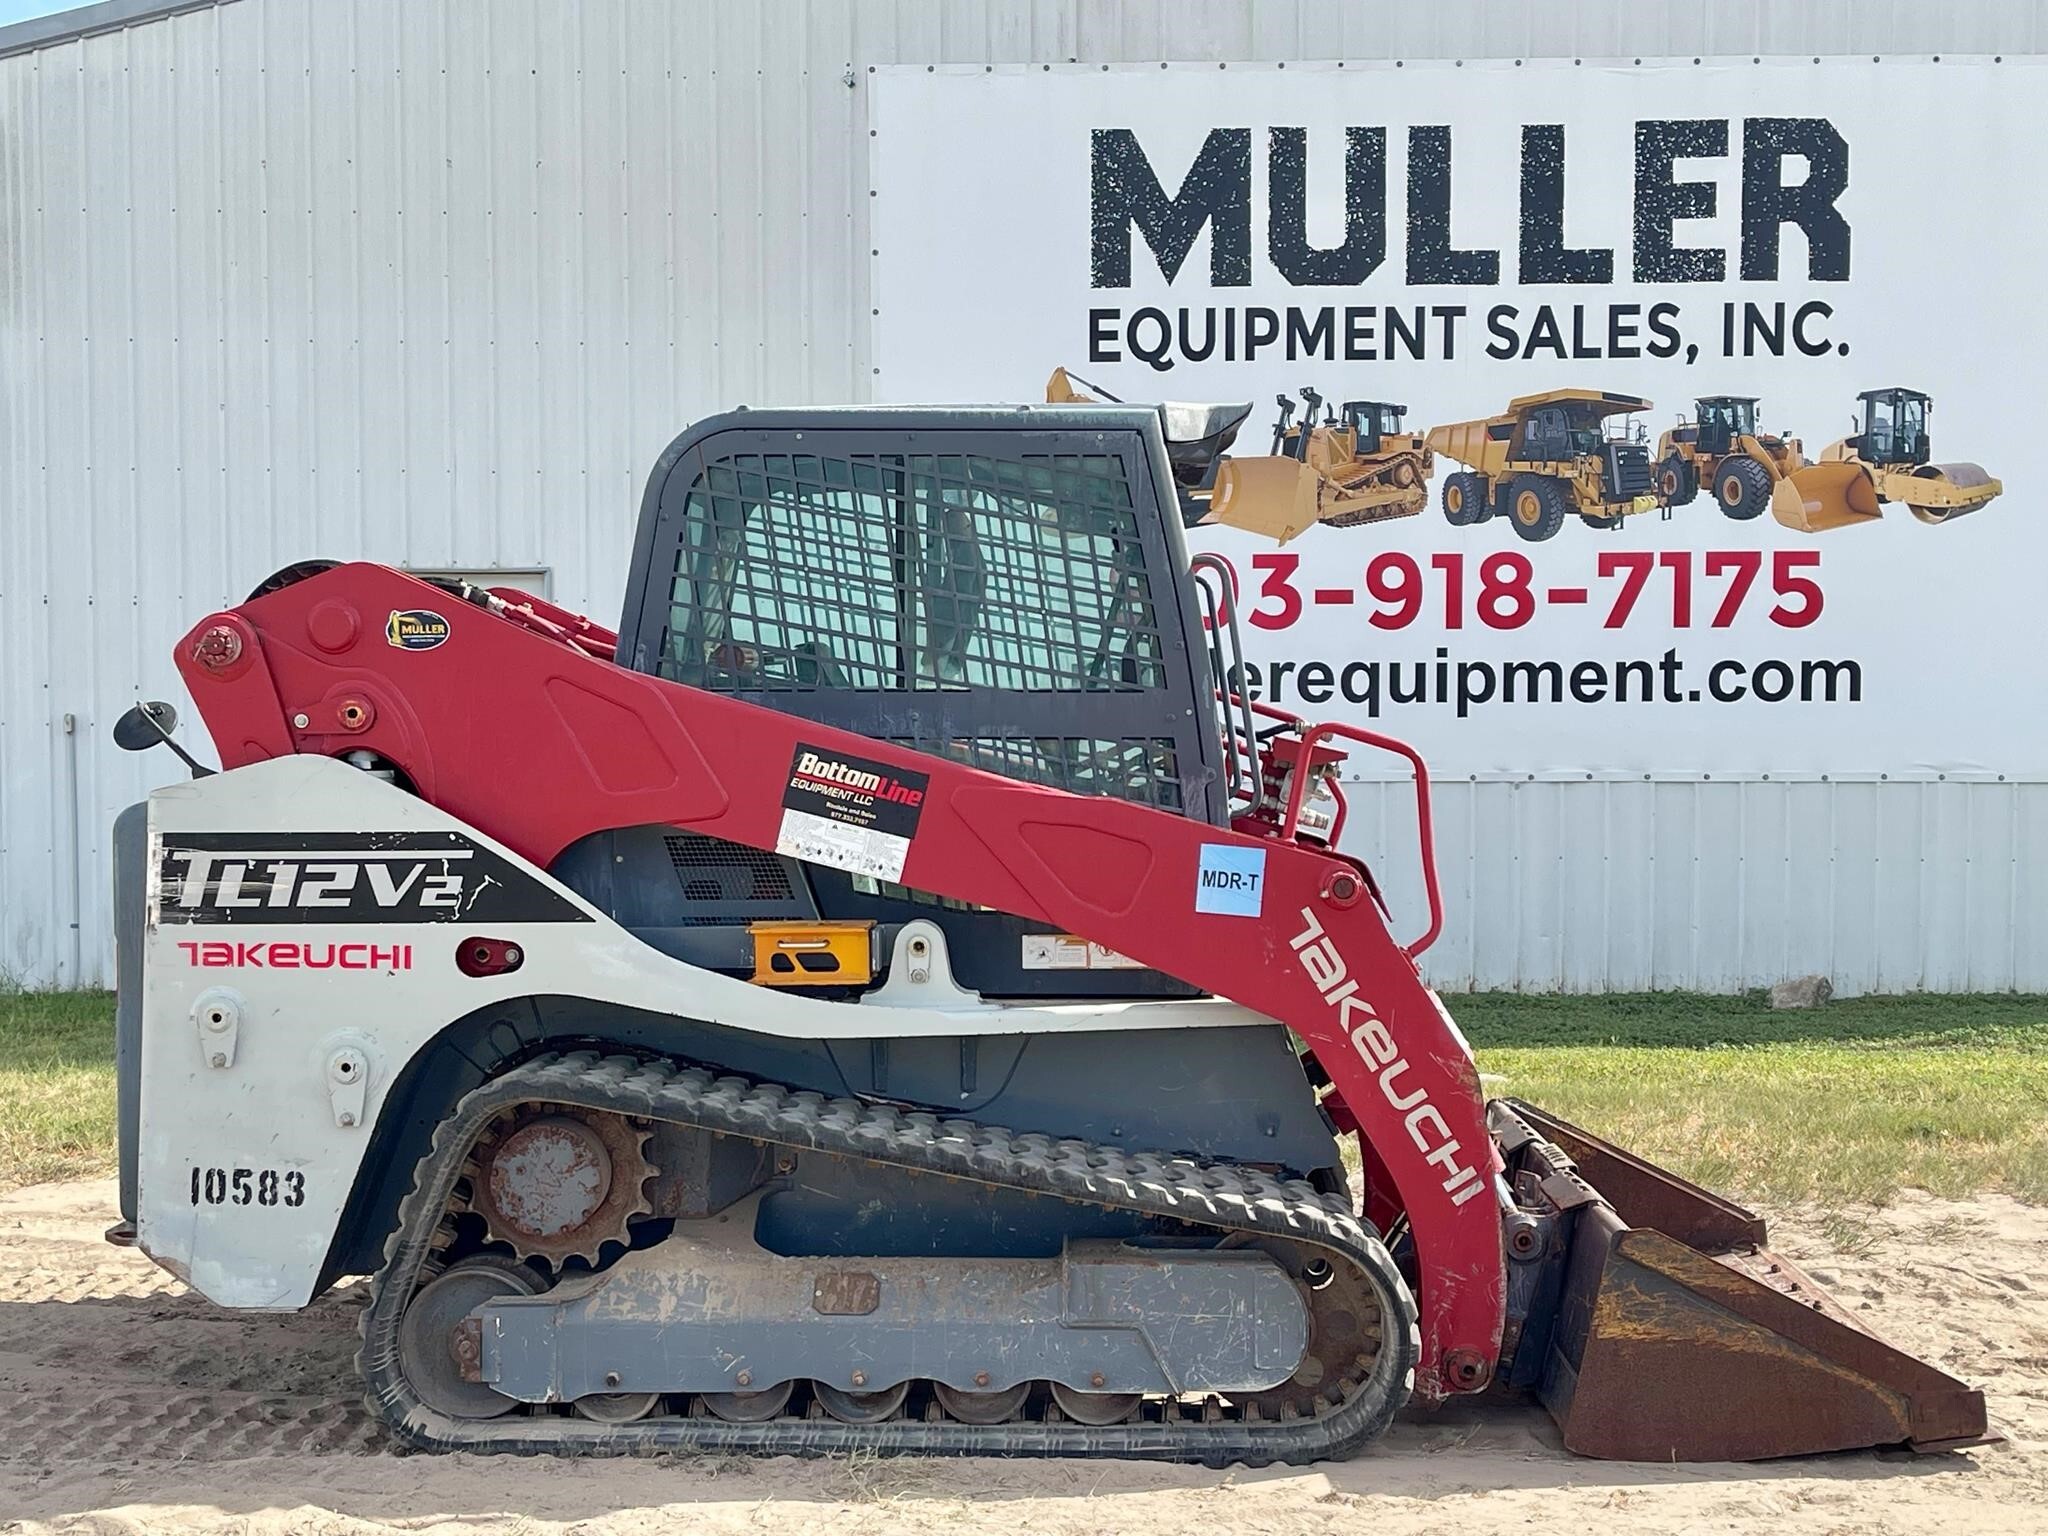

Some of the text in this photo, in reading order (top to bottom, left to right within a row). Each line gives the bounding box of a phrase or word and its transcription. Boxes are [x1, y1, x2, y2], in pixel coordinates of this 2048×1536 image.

[1091, 117, 1851, 288] MULLER
[1088, 301, 1850, 372] EQUIPMENT SALES, INC.
[401, 624, 445, 634] MULLER
[790, 777, 874, 806] EQUIPMENT LLC
[171, 849, 475, 908] TL12V2
[1202, 869, 1259, 892] MDR-T
[191, 1167, 306, 1207] 10583
